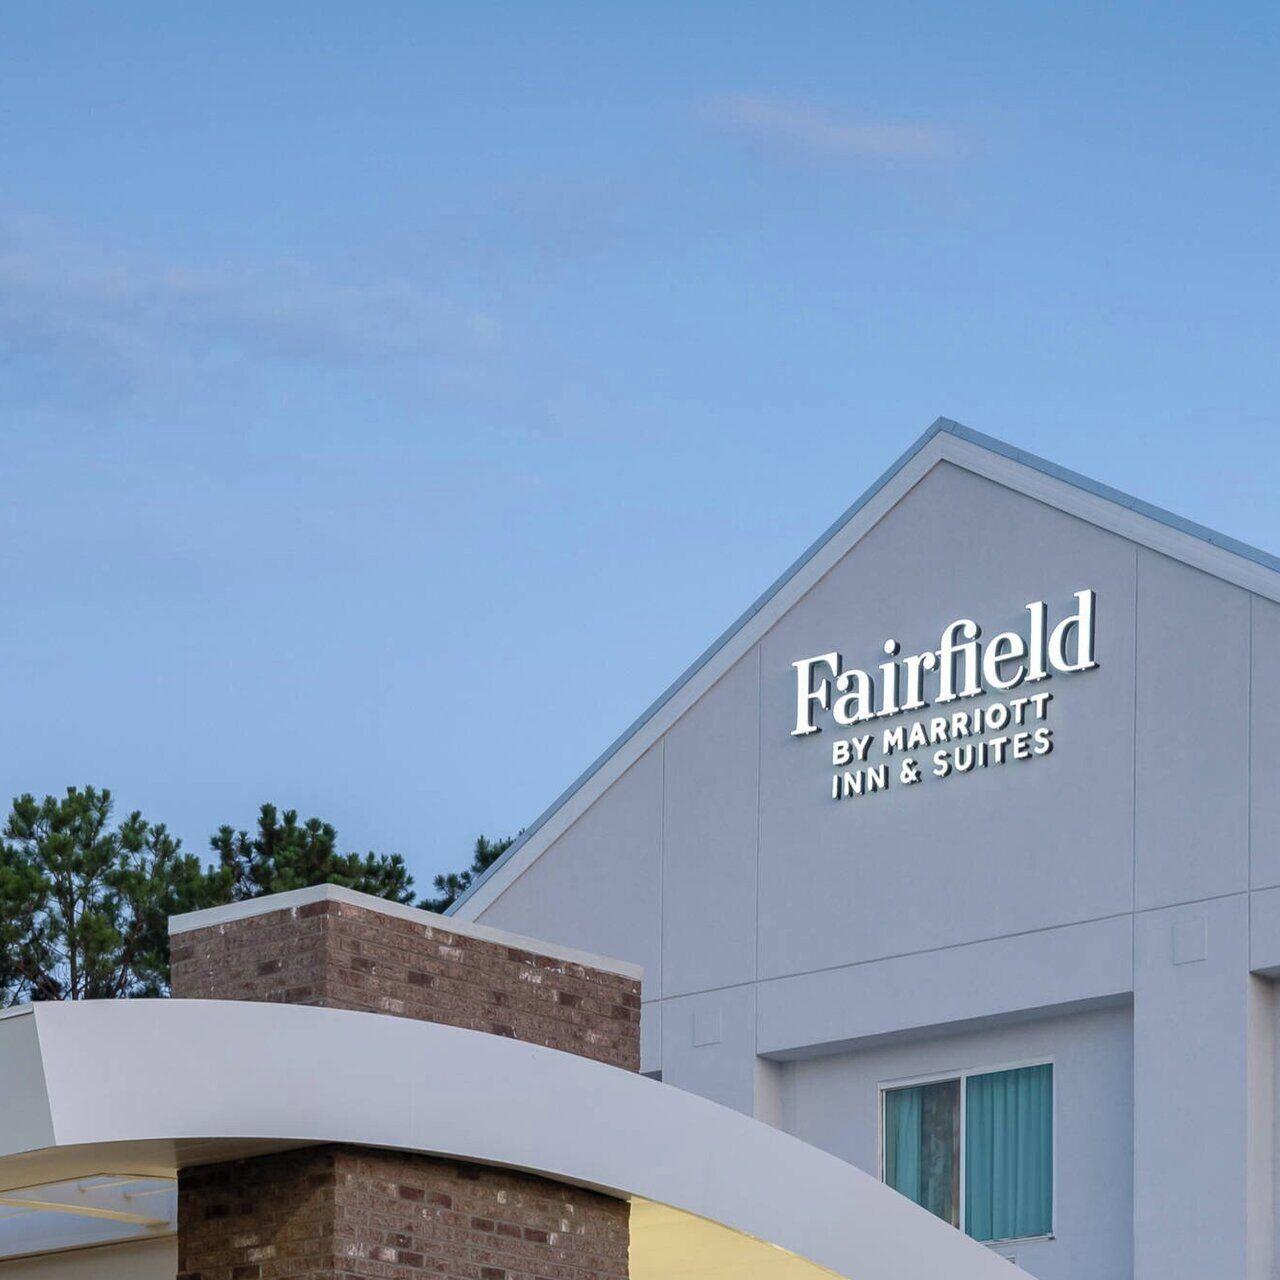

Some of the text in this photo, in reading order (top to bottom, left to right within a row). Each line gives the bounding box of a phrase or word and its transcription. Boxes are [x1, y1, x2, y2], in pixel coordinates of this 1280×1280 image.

[790, 588, 1100, 737] Fairfield
[831, 727, 1054, 801] INN & SUITES
[832, 692, 1054, 767] BY MARRIOTT
